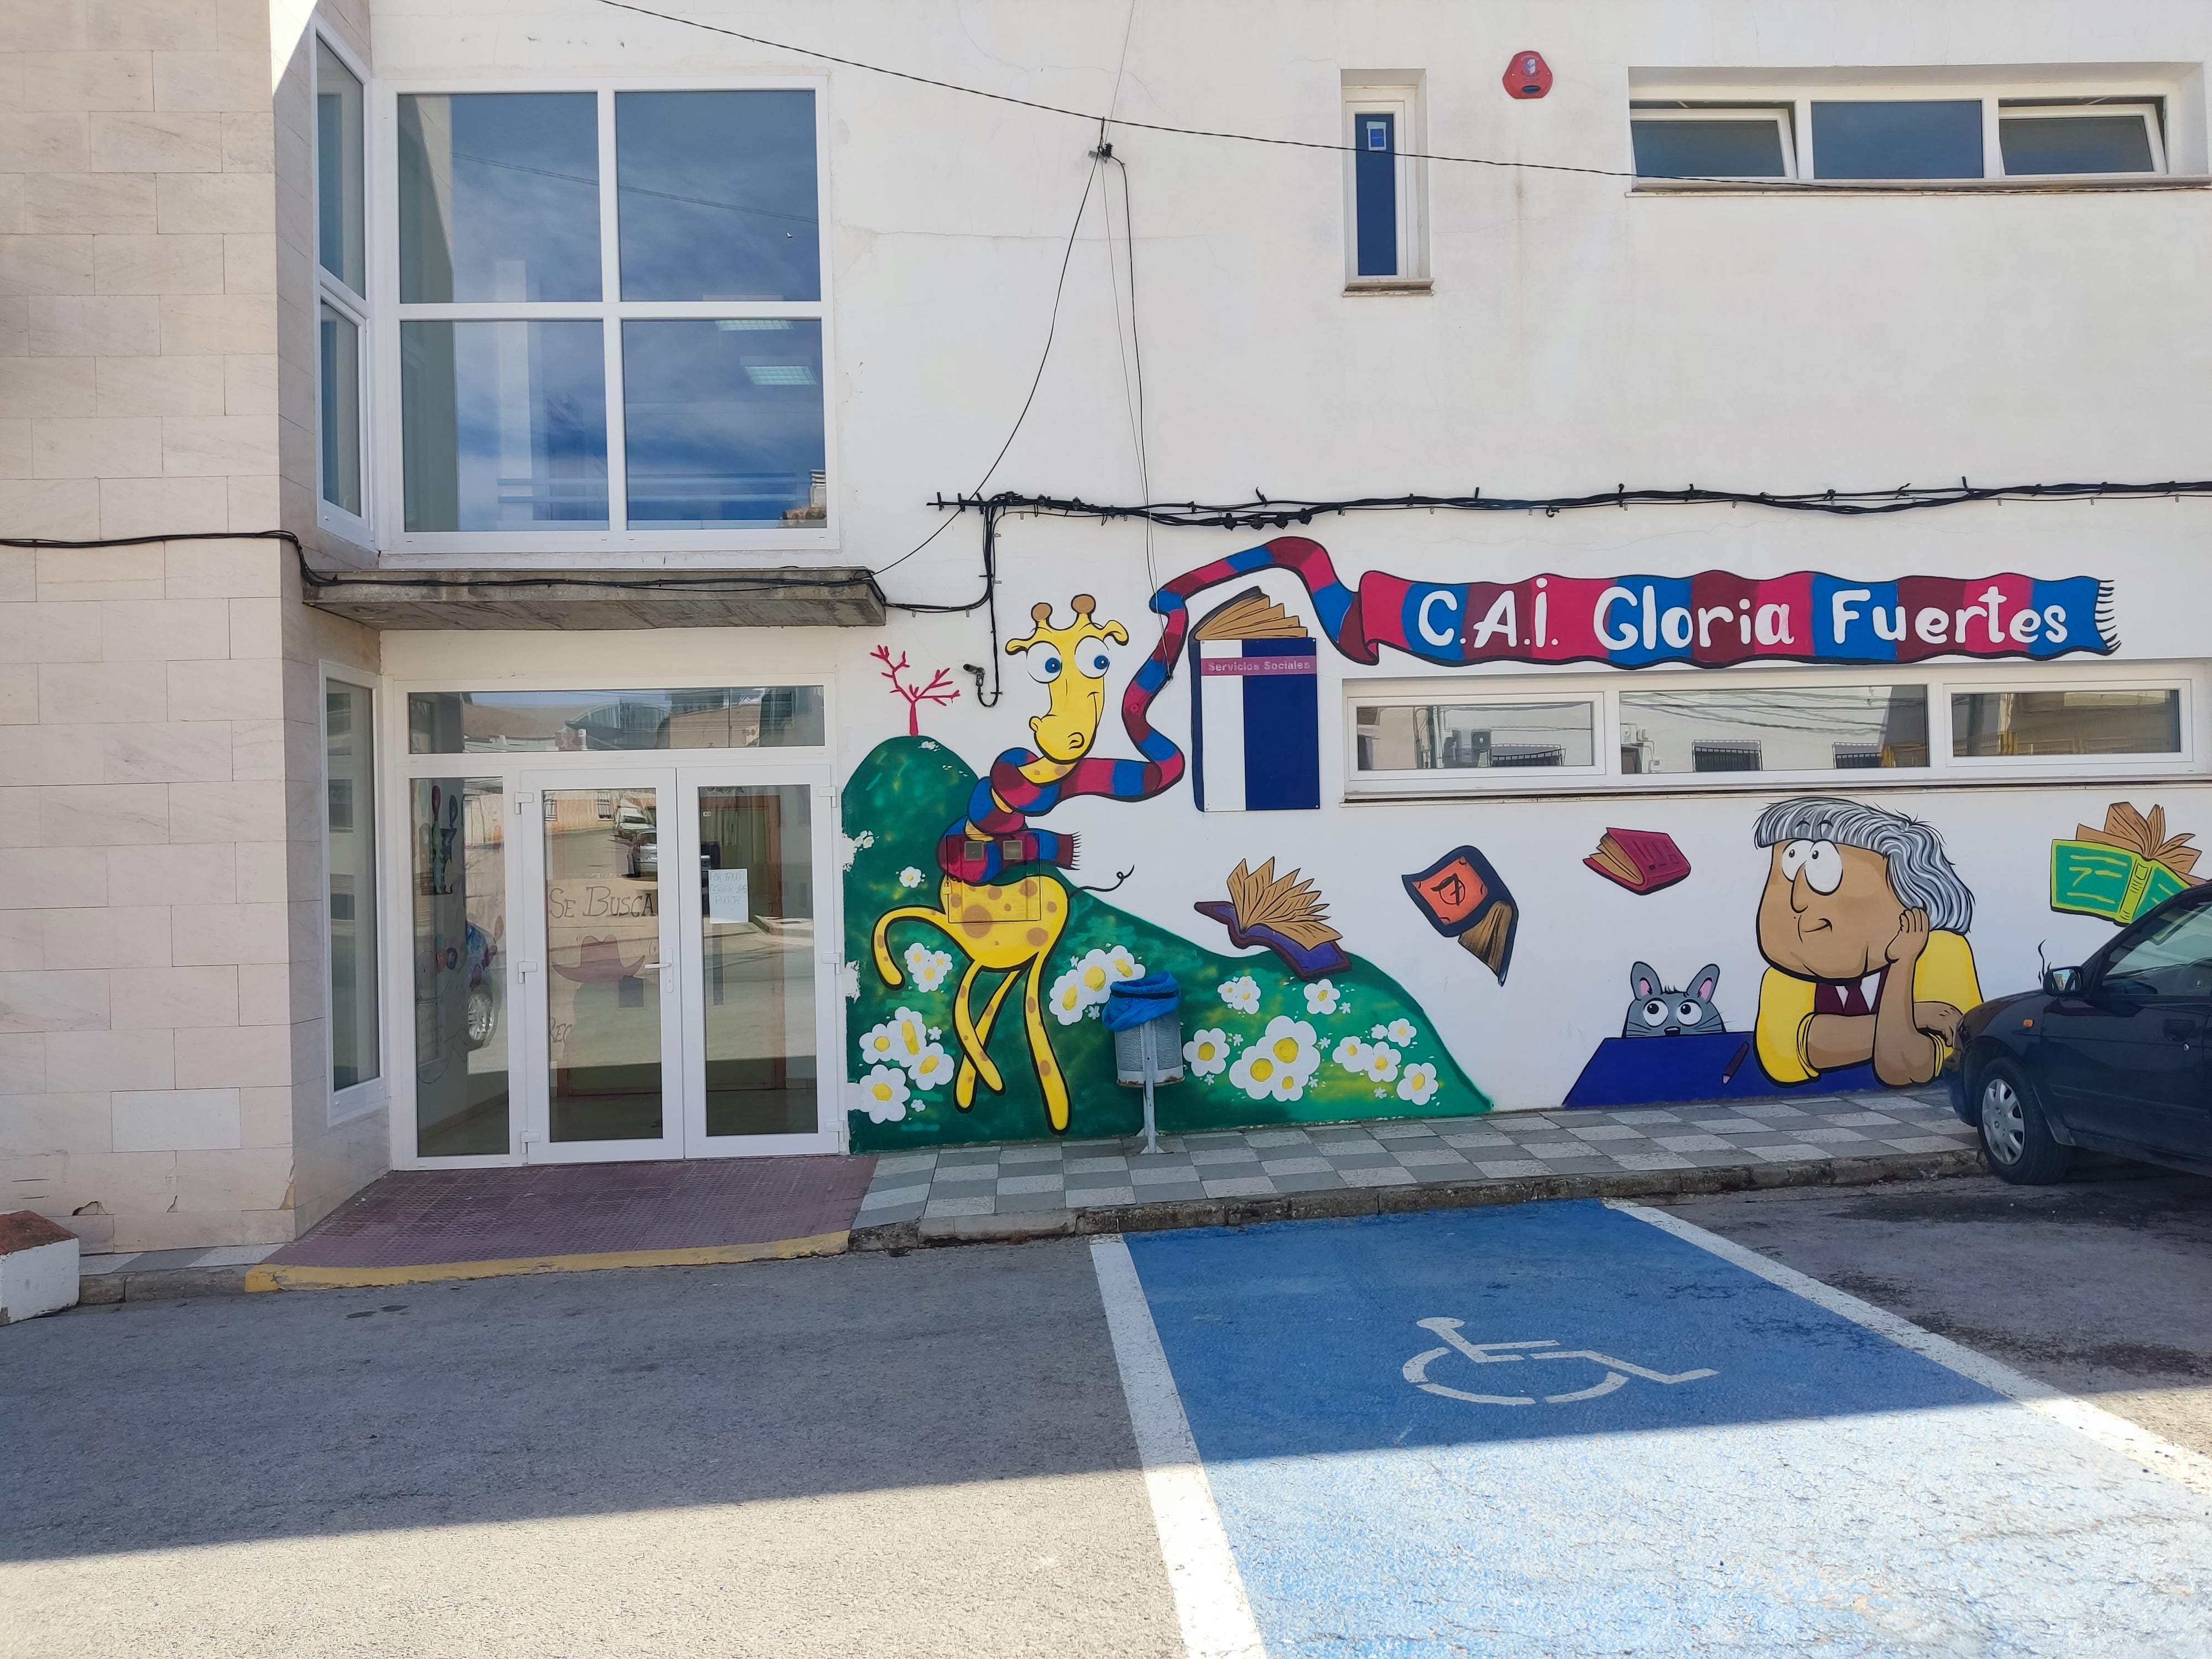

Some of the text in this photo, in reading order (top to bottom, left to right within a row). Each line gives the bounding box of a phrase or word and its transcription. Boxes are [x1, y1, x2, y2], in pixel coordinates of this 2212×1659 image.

[1593, 585, 1795, 651] Gloria
[1831, 585, 2069, 645] Fuertes
[1207, 660, 1311, 671] Servicios Sociales
[549, 885, 656, 919] SE BUSCA
